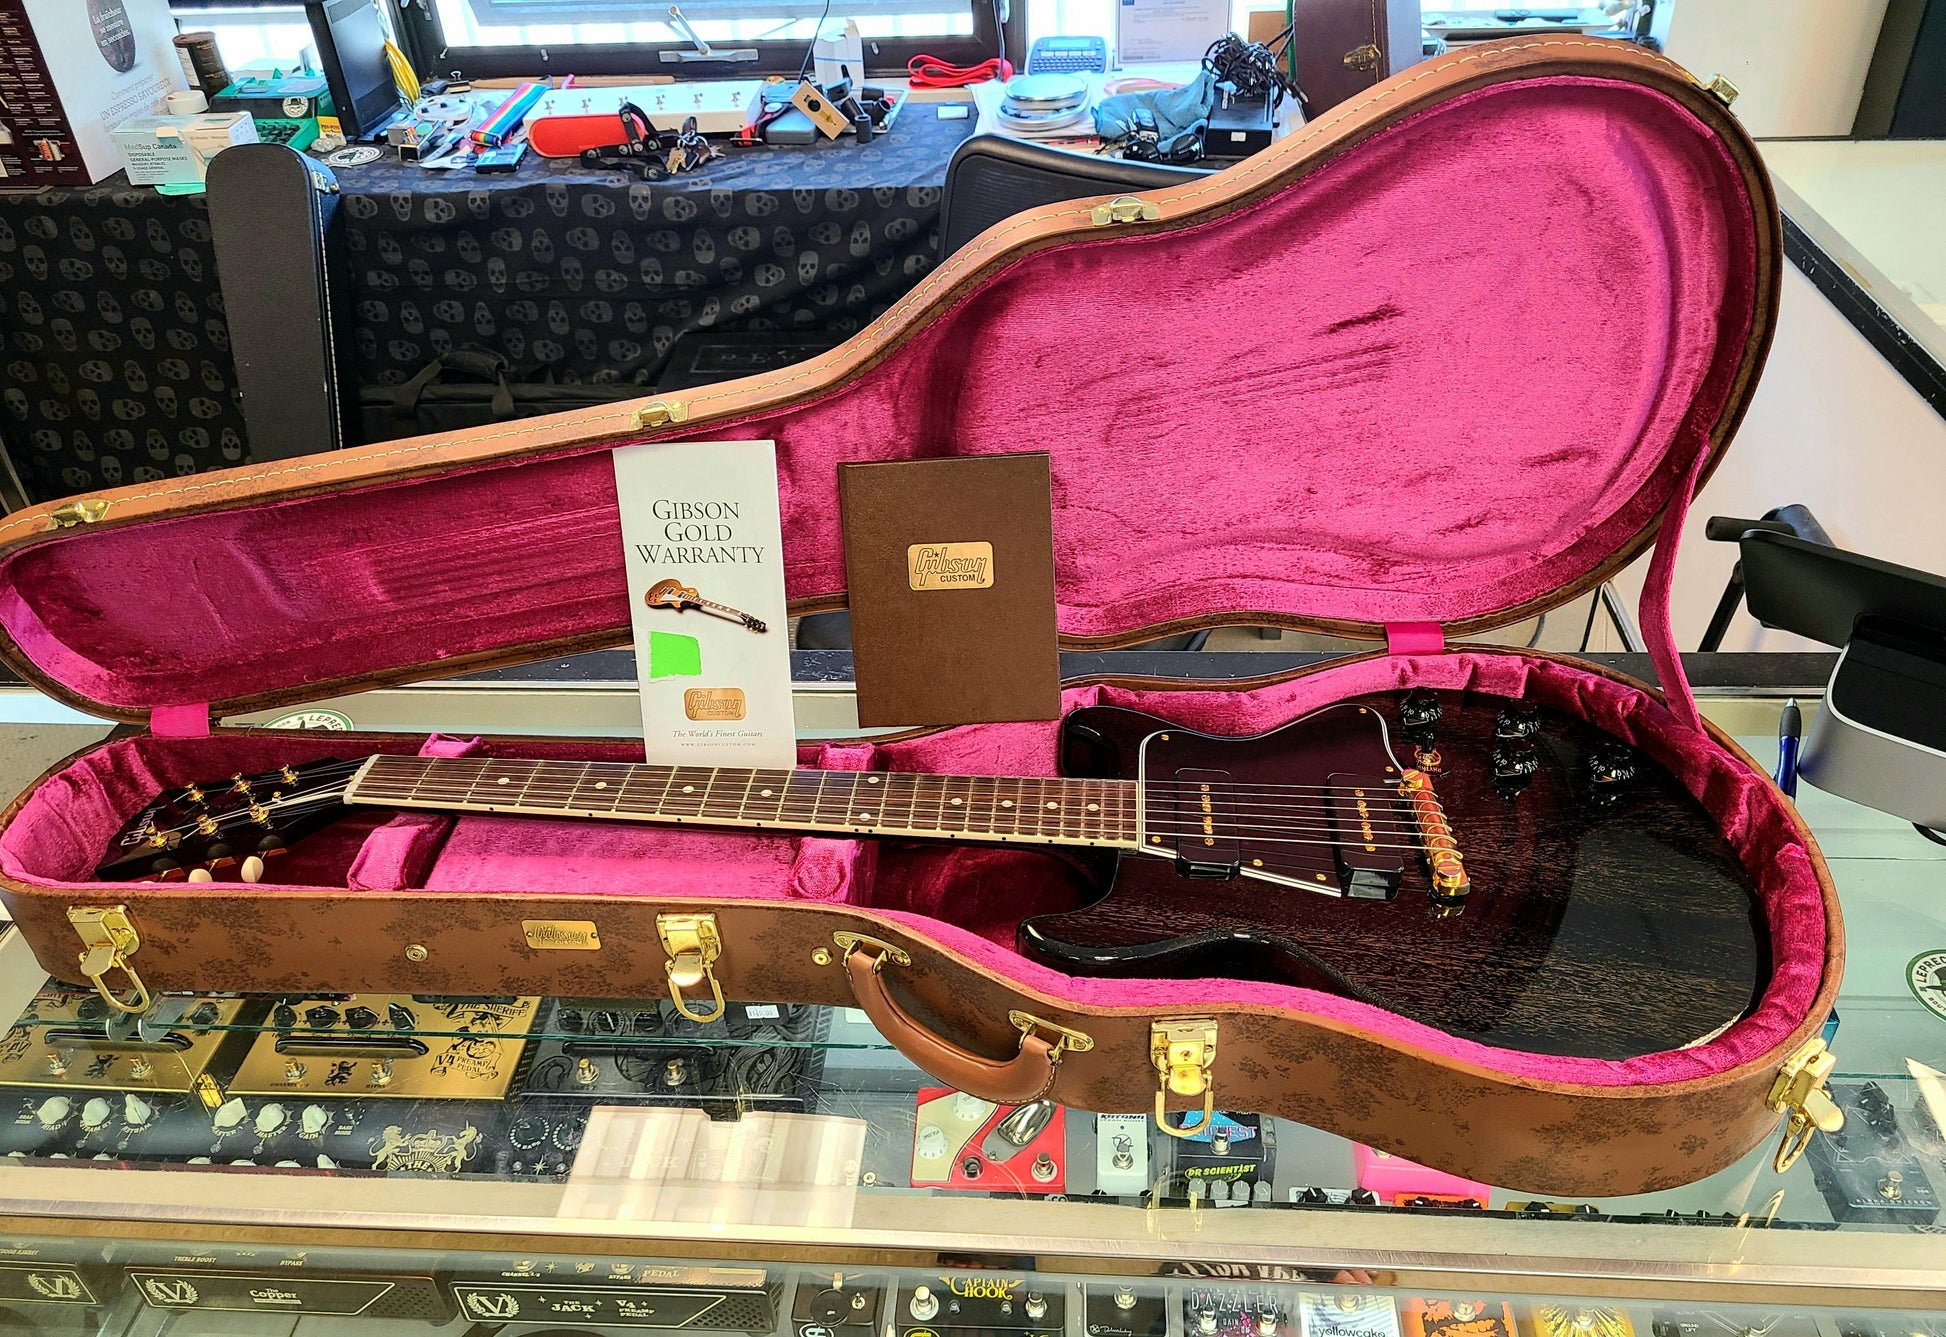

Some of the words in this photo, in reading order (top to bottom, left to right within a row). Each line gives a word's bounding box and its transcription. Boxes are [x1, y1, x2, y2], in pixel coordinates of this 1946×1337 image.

[652, 499, 740, 520] GIBSON
[664, 522, 732, 542] GOLD
[634, 544, 765, 564] WARRANTY
[914, 546, 987, 586] Gibson
[940, 574, 976, 583] CUSTOM
[688, 691, 743, 718] Gibson
[672, 730, 686, 738] The
[688, 730, 714, 738] World's
[715, 730, 736, 738] Finest
[738, 729, 763, 738] Guitars
[534, 925, 588, 945] Gibson
[486, 1003, 526, 1017] SHERIFF
[437, 1053, 455, 1066] V4
[456, 1056, 490, 1068] PREAMP
[457, 1063, 481, 1073] PEDAL
[298, 1132, 319, 1140] GAIN
[405, 1160, 431, 1170] THE
[1188, 1167, 1201, 1177] DR
[1203, 1163, 1256, 1176] SCIENTIST
[950, 1276, 1010, 1296] CAPTAIN
[250, 1289, 297, 1300] Copper
[963, 1287, 1013, 1300] HOOK
[551, 1303, 596, 1313] JACK
[1191, 1291, 1279, 1314] DAZZLER
[1318, 1326, 1386, 1337] yellowcake
